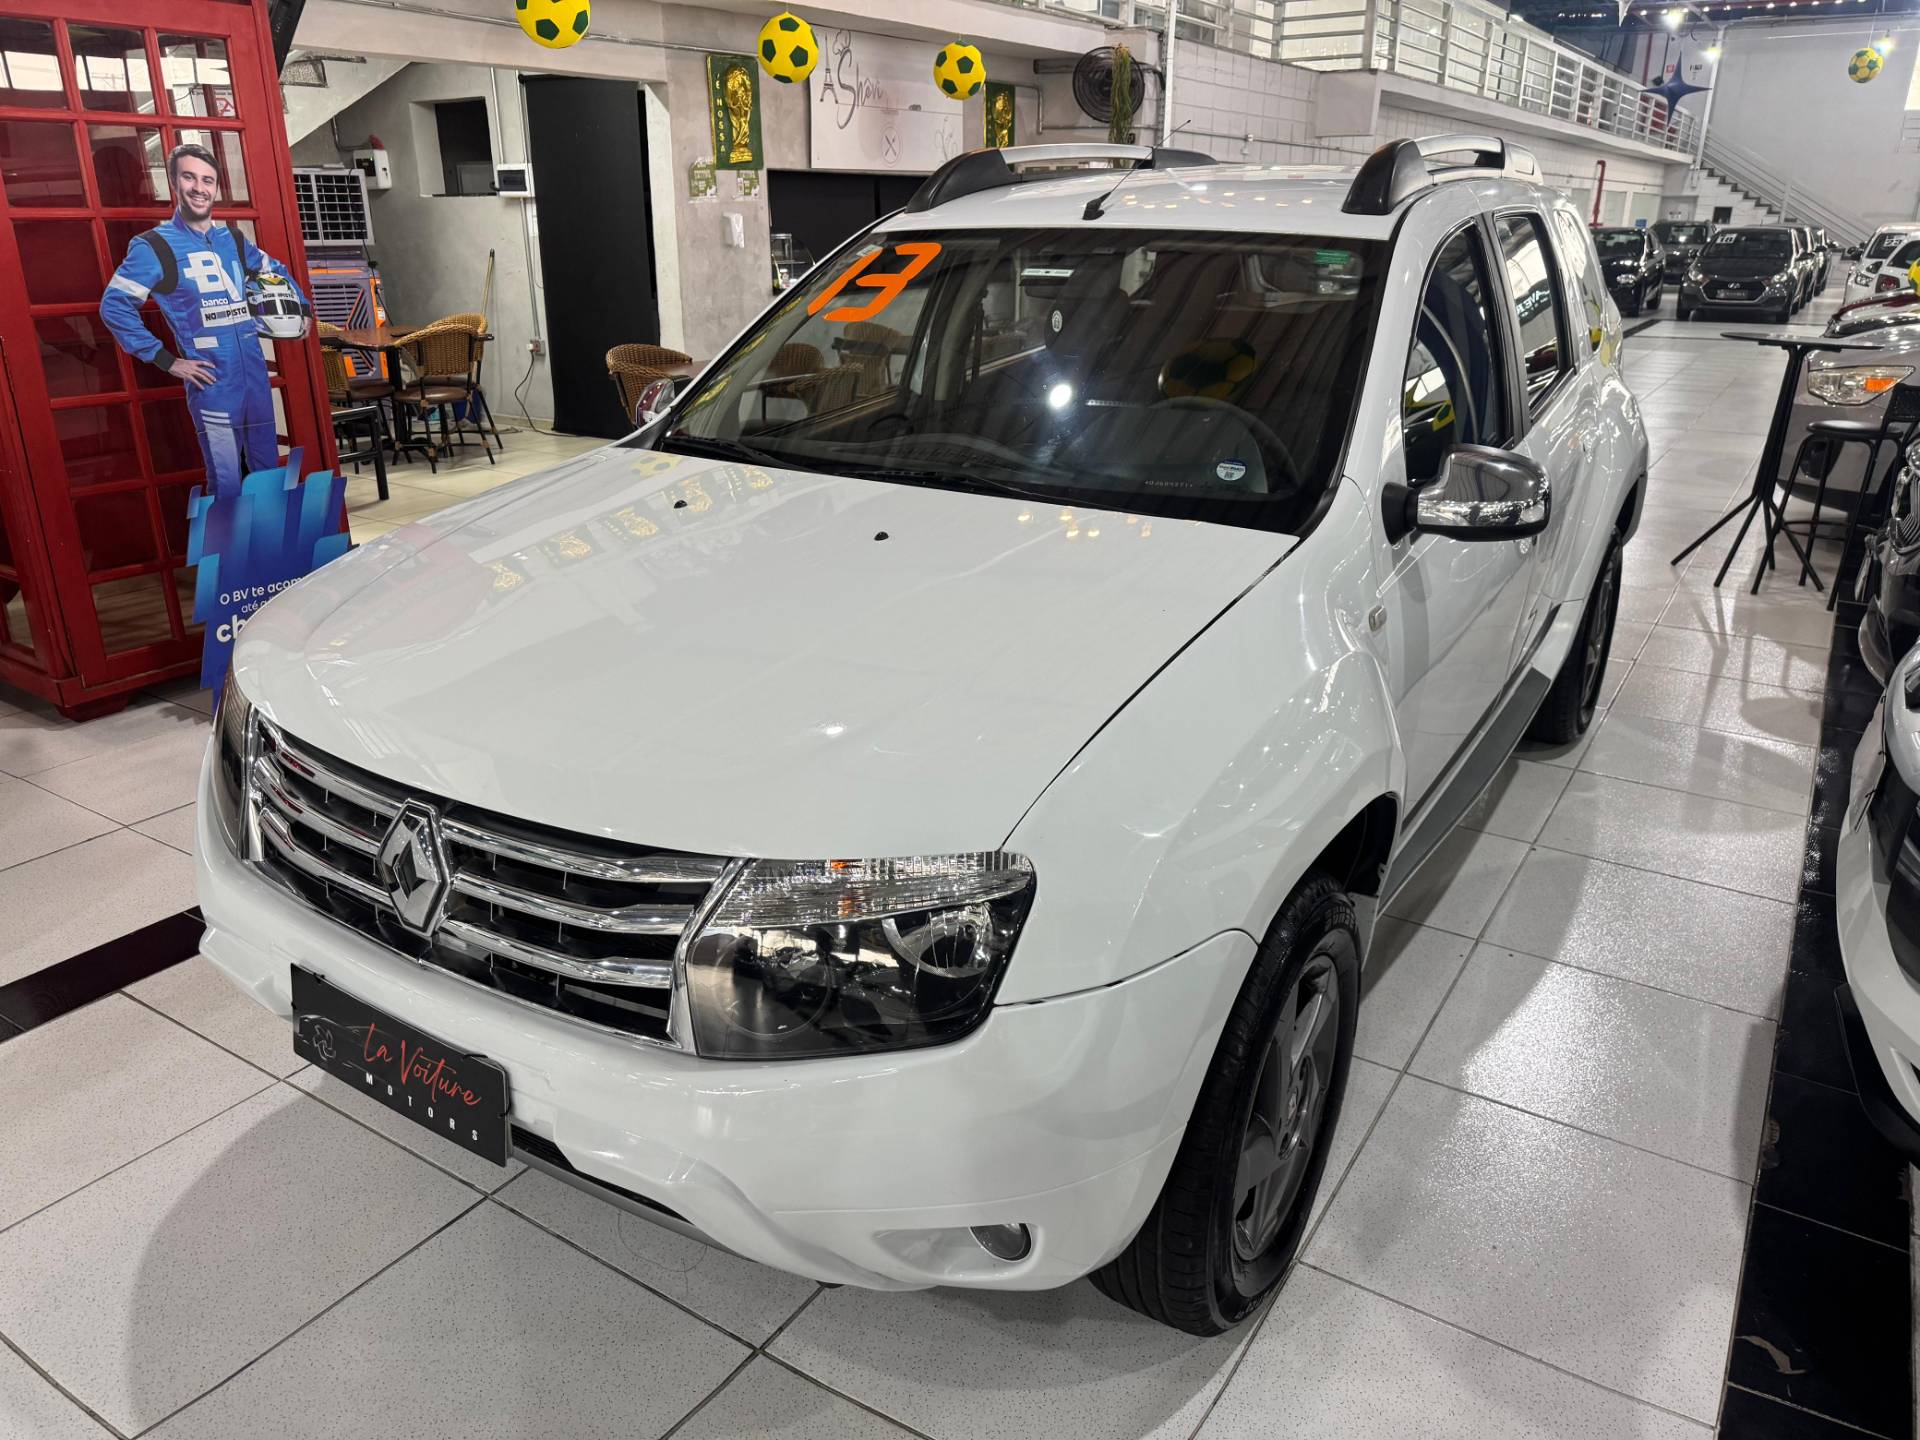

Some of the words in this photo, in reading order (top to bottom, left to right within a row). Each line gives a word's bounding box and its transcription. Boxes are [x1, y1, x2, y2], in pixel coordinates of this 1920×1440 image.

[716, 98, 726, 152] NOSSA
[183, 251, 243, 301] BV
[807, 242, 942, 322] 13
[201, 298, 229, 307] banco
[220, 594, 230, 605] O
[233, 588, 249, 602] BV
[252, 586, 265, 597] te
[241, 600, 258, 613] até
[363, 1023, 392, 1062] La
[401, 1039, 481, 1106] Voiture
[366, 1073, 478, 1141] MOTORS
